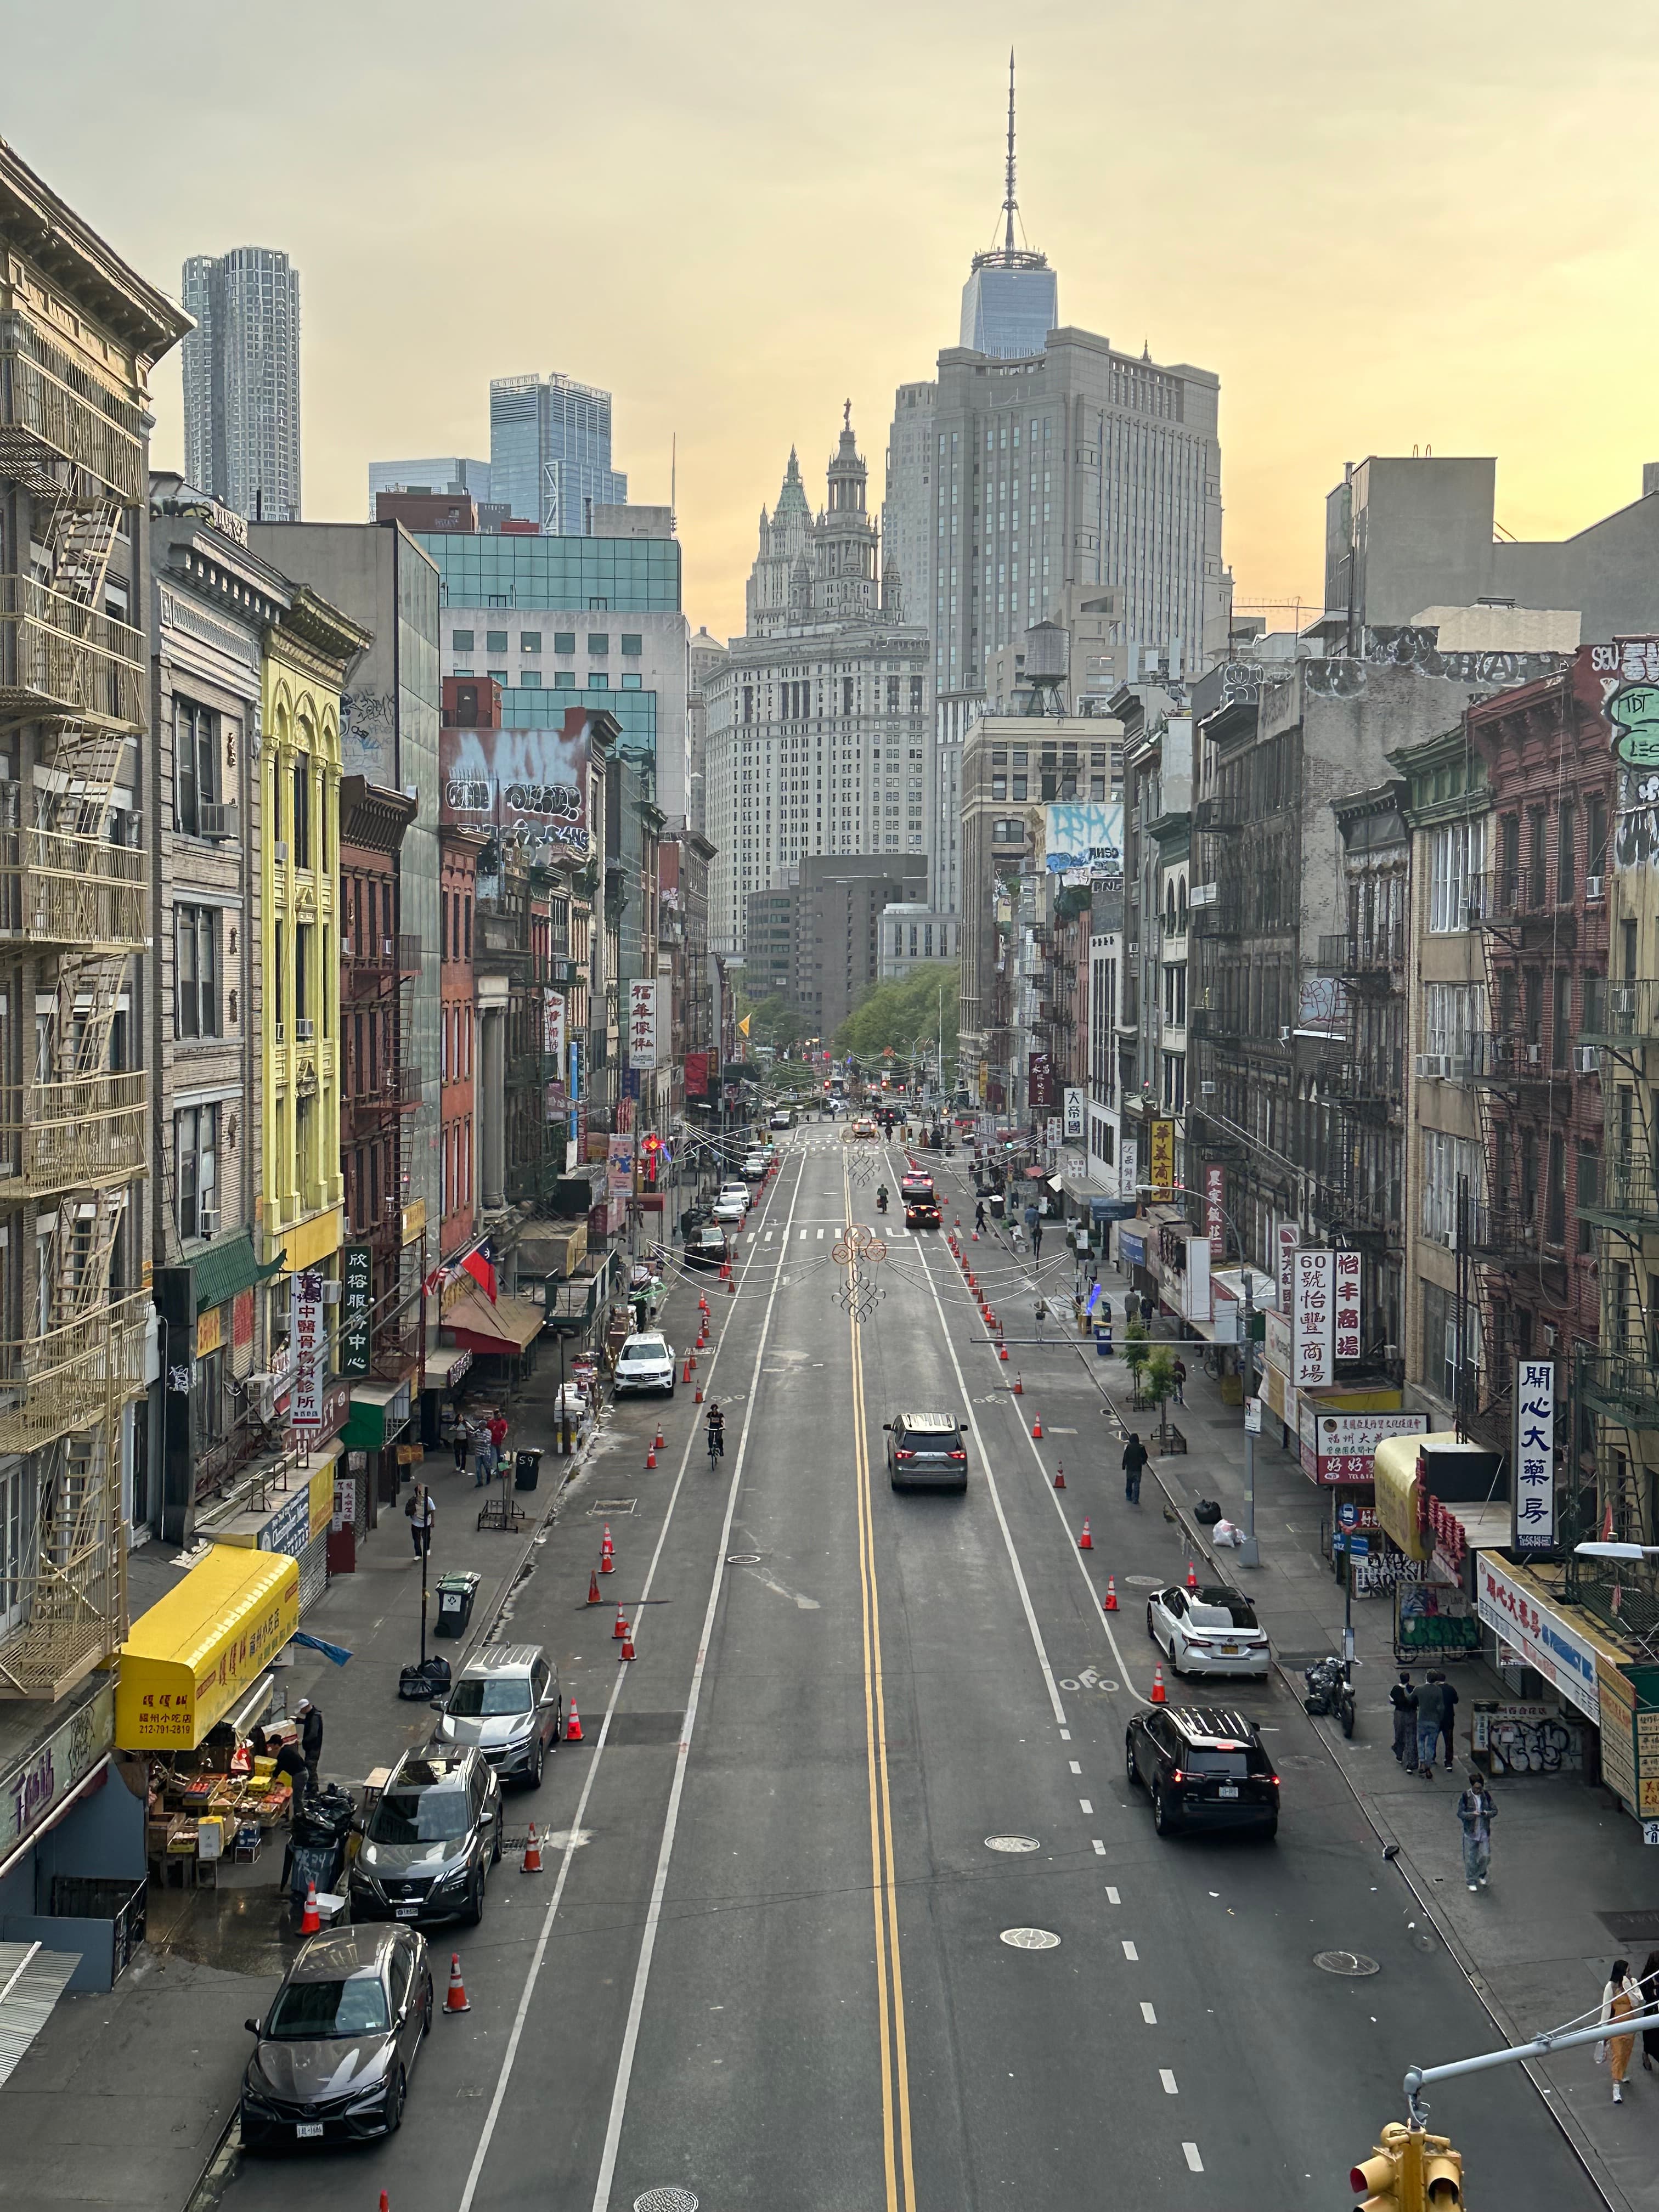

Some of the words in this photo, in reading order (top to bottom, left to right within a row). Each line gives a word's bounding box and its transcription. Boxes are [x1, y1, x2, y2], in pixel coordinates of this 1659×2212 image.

[1518, 1365, 1551, 1525] 開心大藥房
